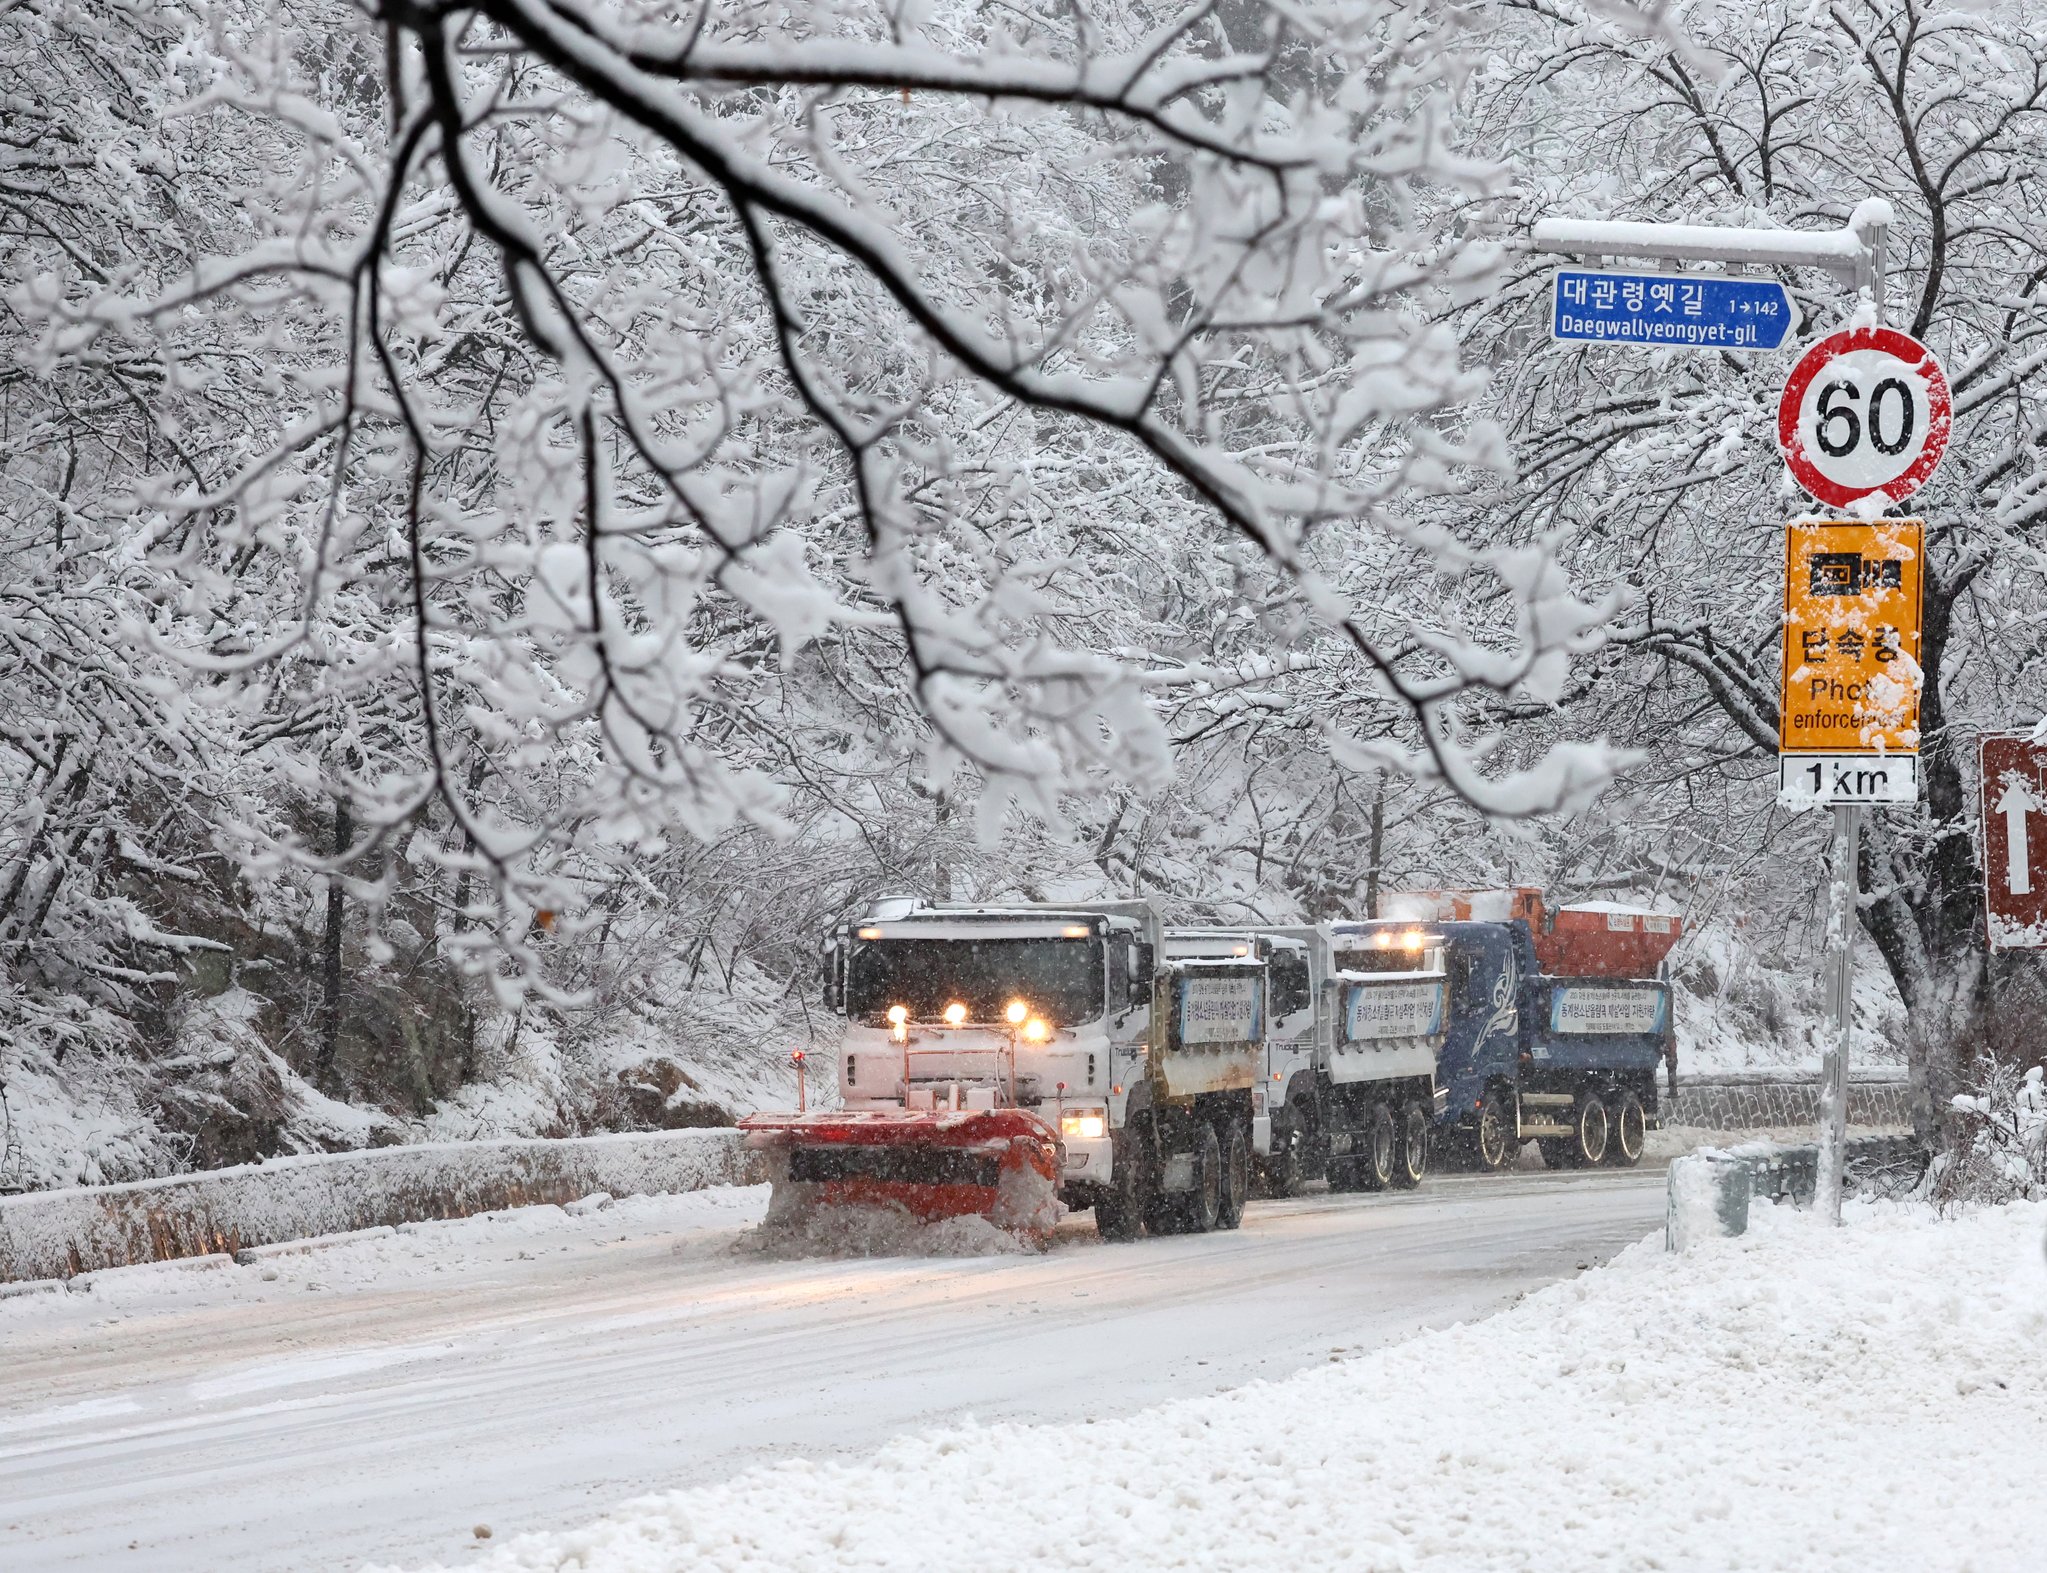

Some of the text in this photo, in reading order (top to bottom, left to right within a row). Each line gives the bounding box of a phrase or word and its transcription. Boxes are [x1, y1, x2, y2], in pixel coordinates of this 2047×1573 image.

[1563, 279, 1703, 316] 대관령옛길
[1561, 315, 1758, 345] Daegwallyeongyet-gil
[1816, 377, 1914, 458] 60
[1810, 678, 1880, 701] Pho
[1794, 709, 1906, 729] enforcet
